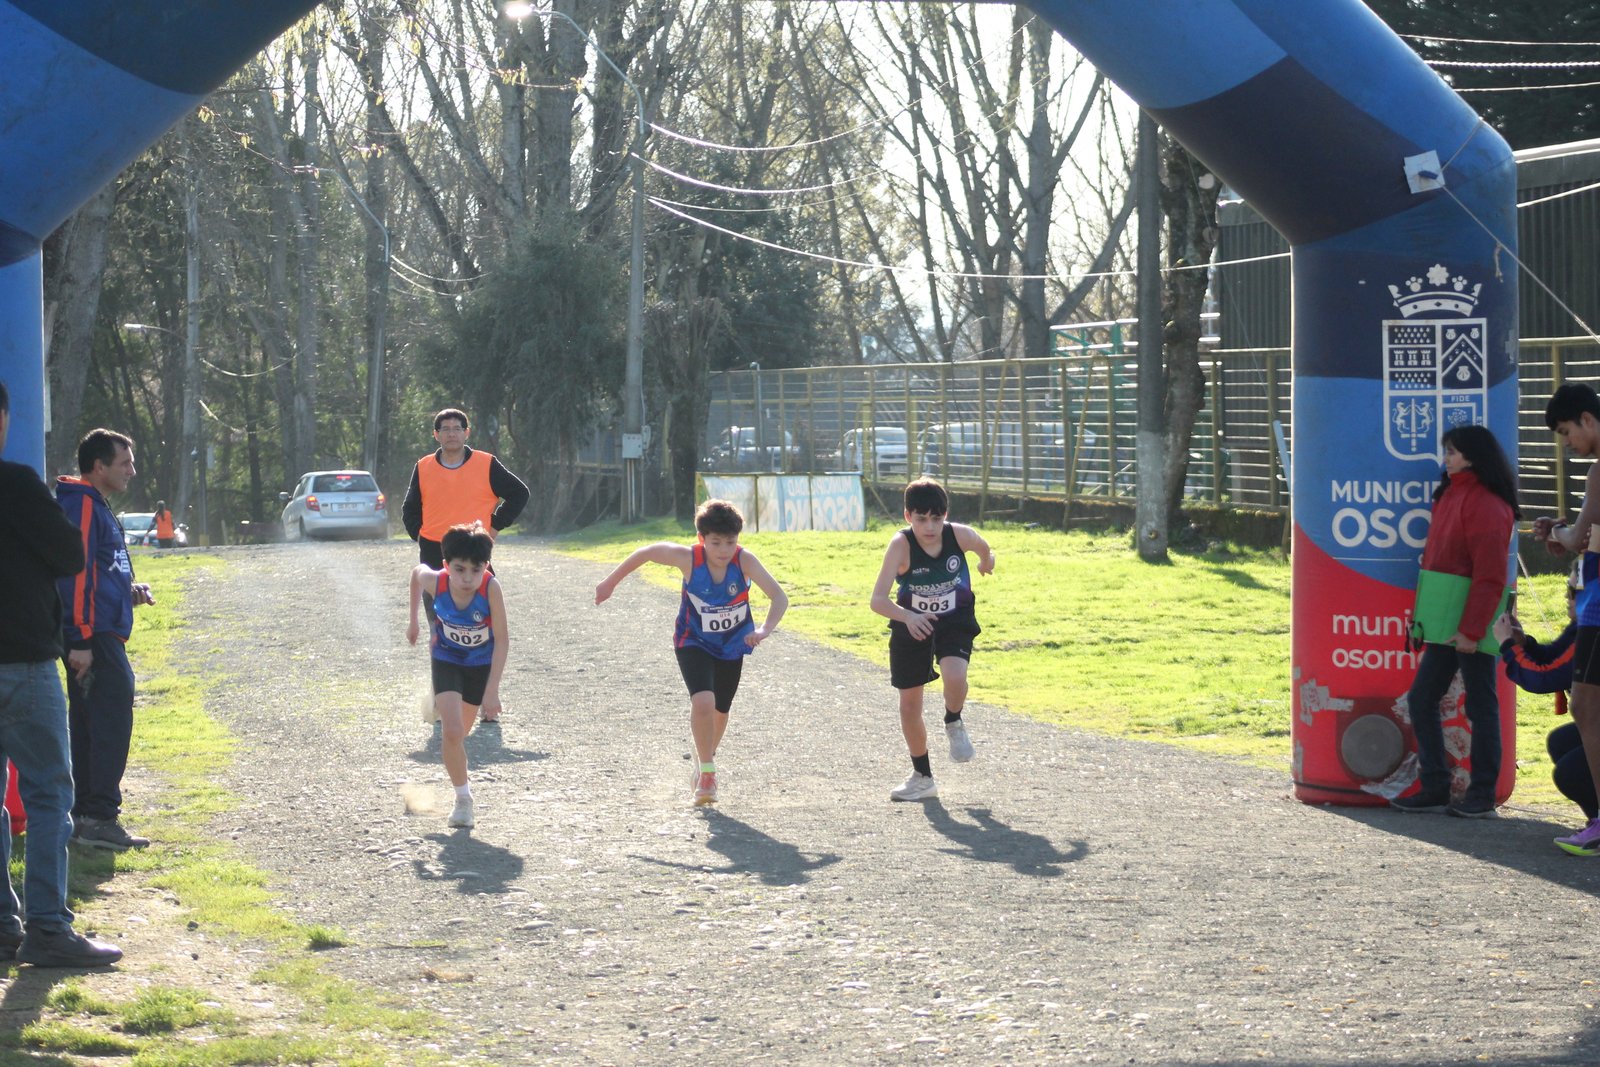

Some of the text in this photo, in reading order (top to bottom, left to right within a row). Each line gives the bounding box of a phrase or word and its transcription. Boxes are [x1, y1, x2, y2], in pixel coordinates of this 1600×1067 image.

[918, 600, 949, 612] 003
[709, 614, 739, 631] 001
[450, 632, 482, 645] 002
[1331, 648, 1423, 669] osorn
